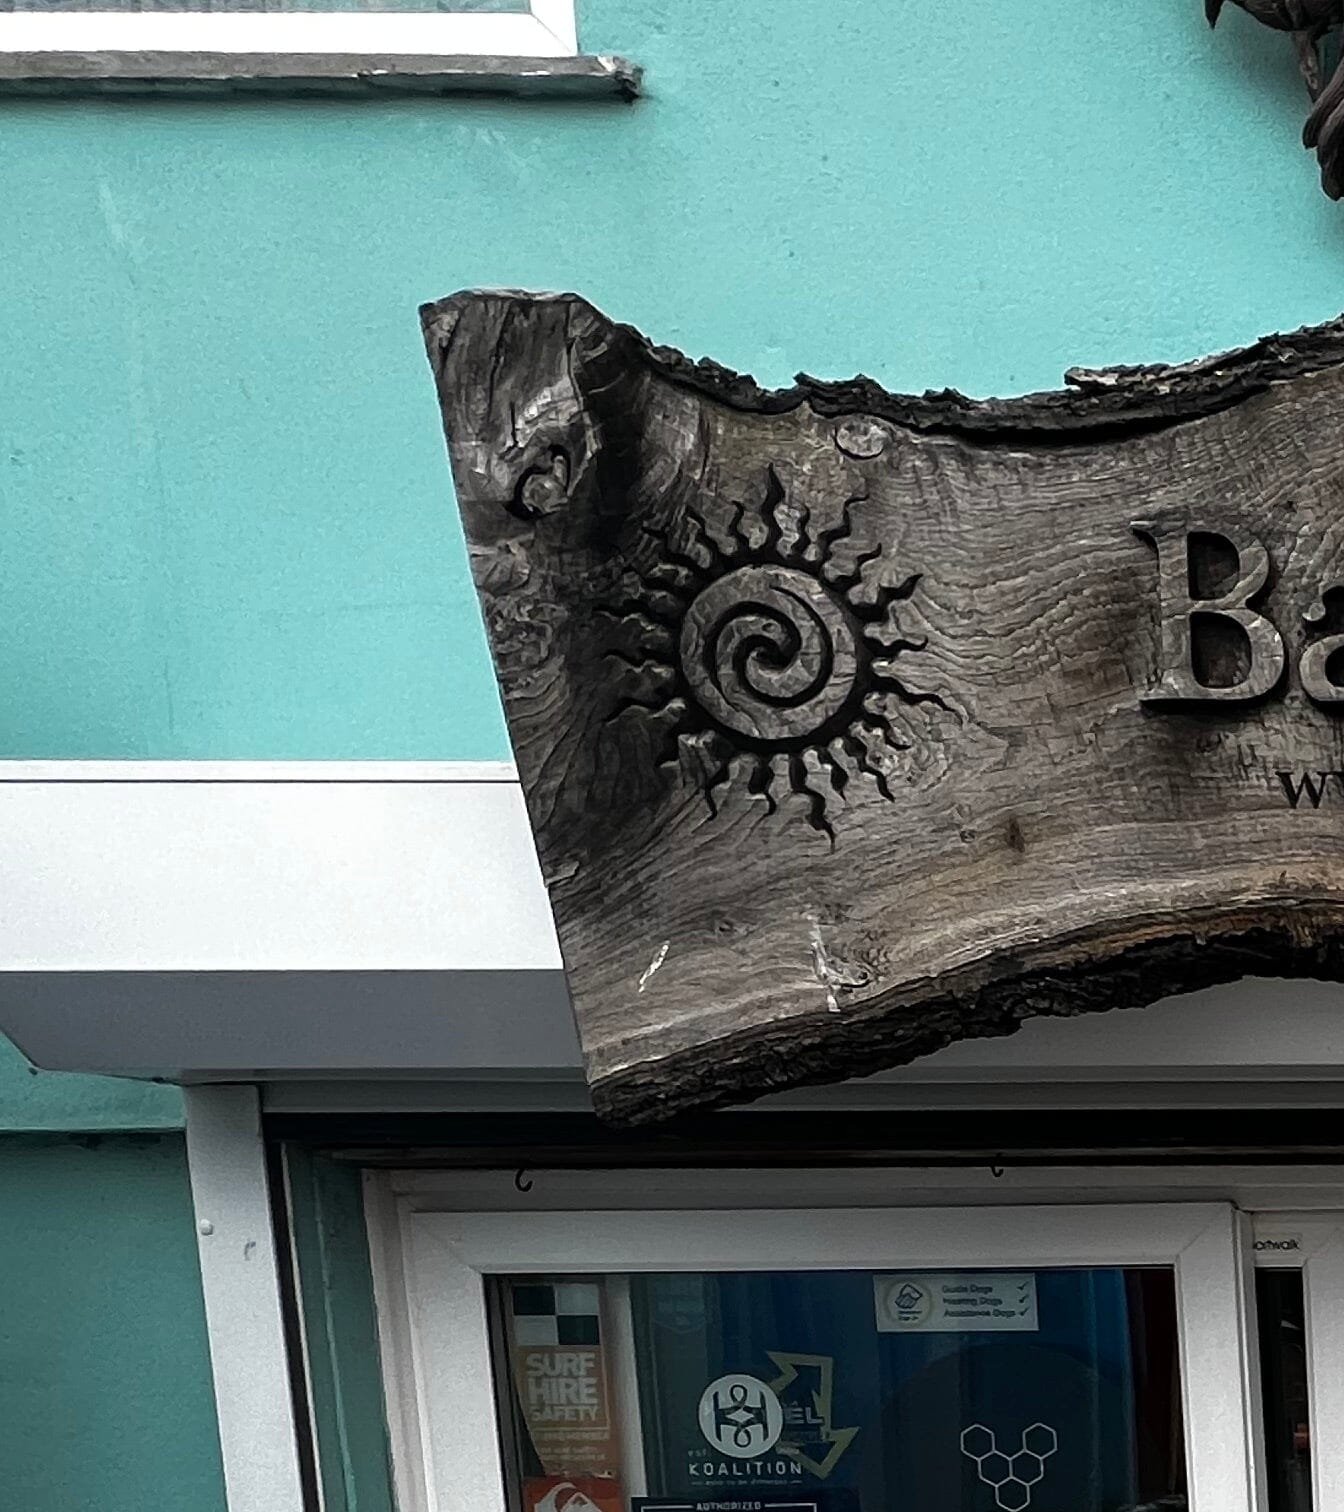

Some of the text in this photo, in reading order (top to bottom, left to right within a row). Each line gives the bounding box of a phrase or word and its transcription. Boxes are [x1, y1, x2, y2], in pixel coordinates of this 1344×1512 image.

[526, 1352, 596, 1376] SURF
[527, 1377, 599, 1404] HIRE
[529, 1405, 598, 1421] SAFETY
[689, 1460, 803, 1476] KOALITION
[695, 1501, 762, 1512] AUTHORIZED
